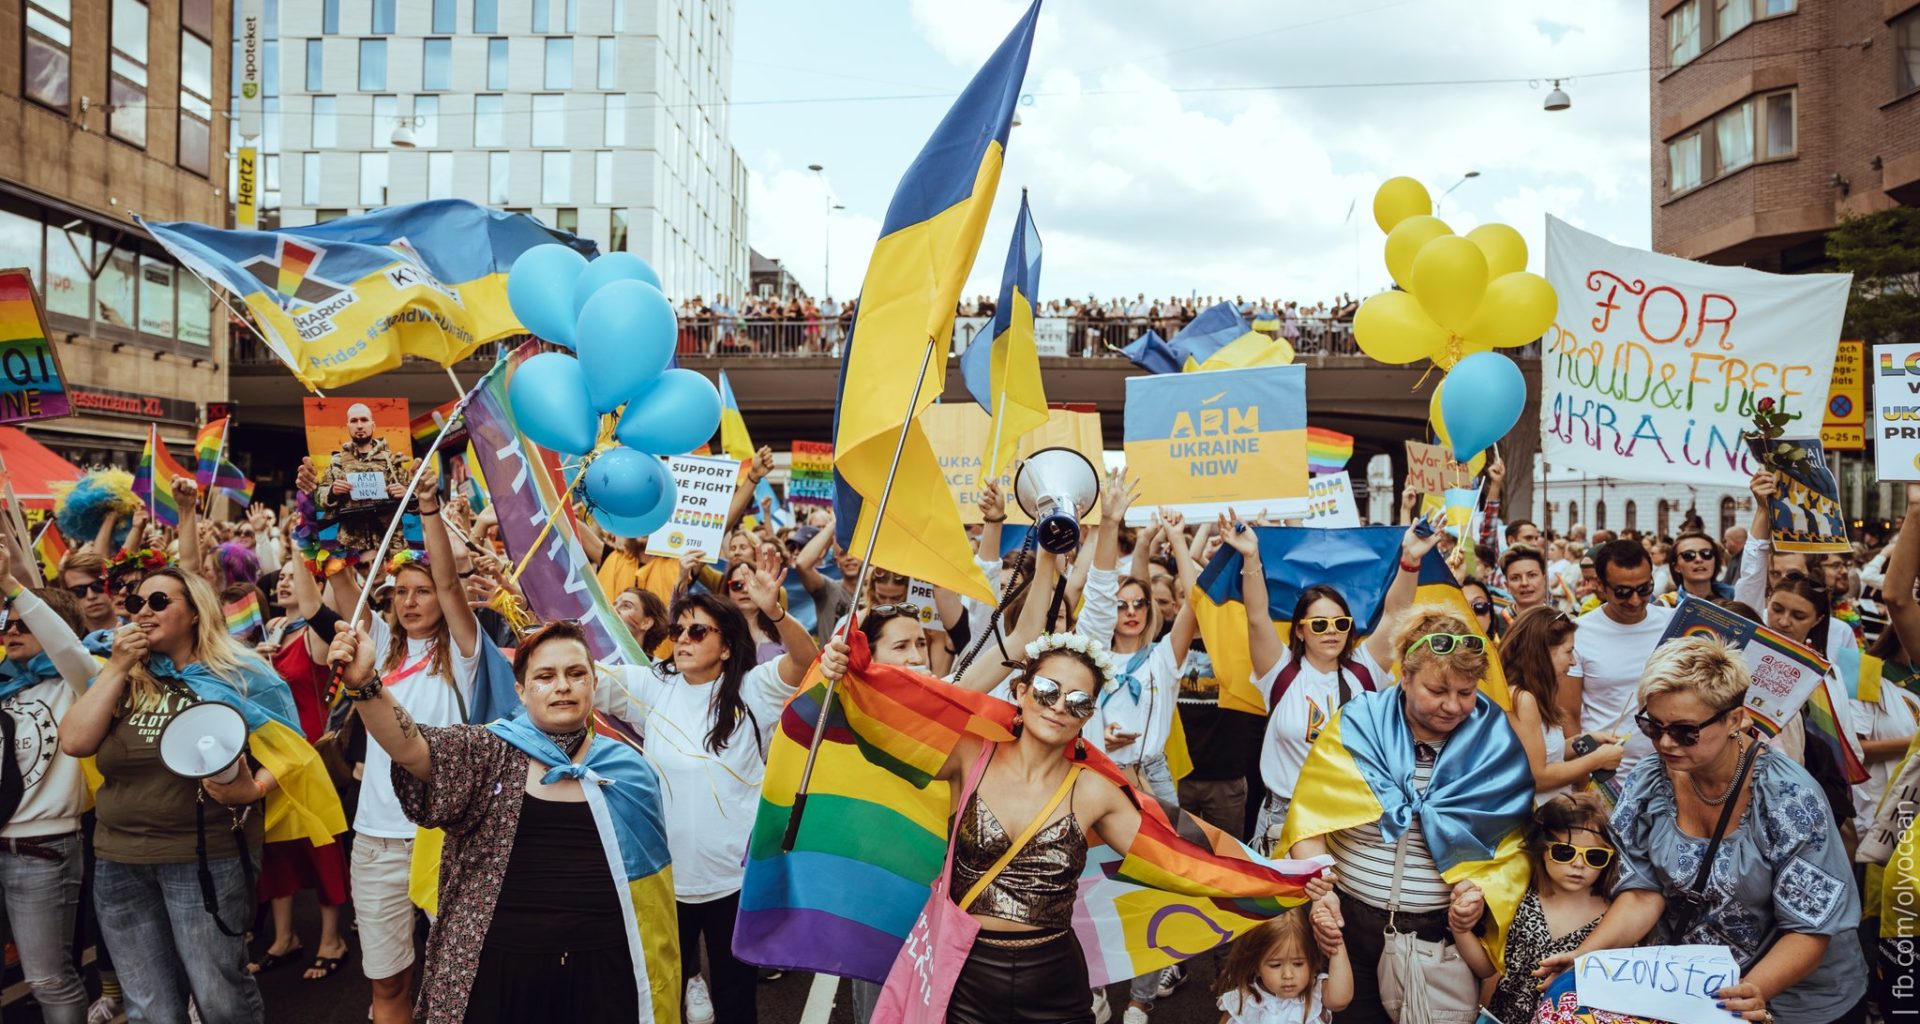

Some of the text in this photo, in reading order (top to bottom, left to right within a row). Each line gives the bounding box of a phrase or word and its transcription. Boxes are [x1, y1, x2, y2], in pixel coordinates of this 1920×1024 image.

[244, 16, 257, 81] apoteket
[238, 157, 254, 206] Hertz
[1586, 269, 1737, 350] FOR
[310, 338, 367, 368] Prides
[1169, 404, 1260, 438] ARM
[1885, 427, 1920, 439] PR
[1169, 437, 1260, 459] UKRAINE
[1408, 445, 1440, 467] War
[357, 473, 377, 481] ARM
[672, 463, 733, 478] SUPPORT
[1190, 459, 1239, 477] NOW
[674, 479, 733, 494] HE FIGHT
[1409, 467, 1436, 492] My
[681, 495, 708, 506] FOR
[669, 508, 725, 530] EEDOM
[686, 539, 702, 547] STFU
[129, 713, 172, 728] CLOT
